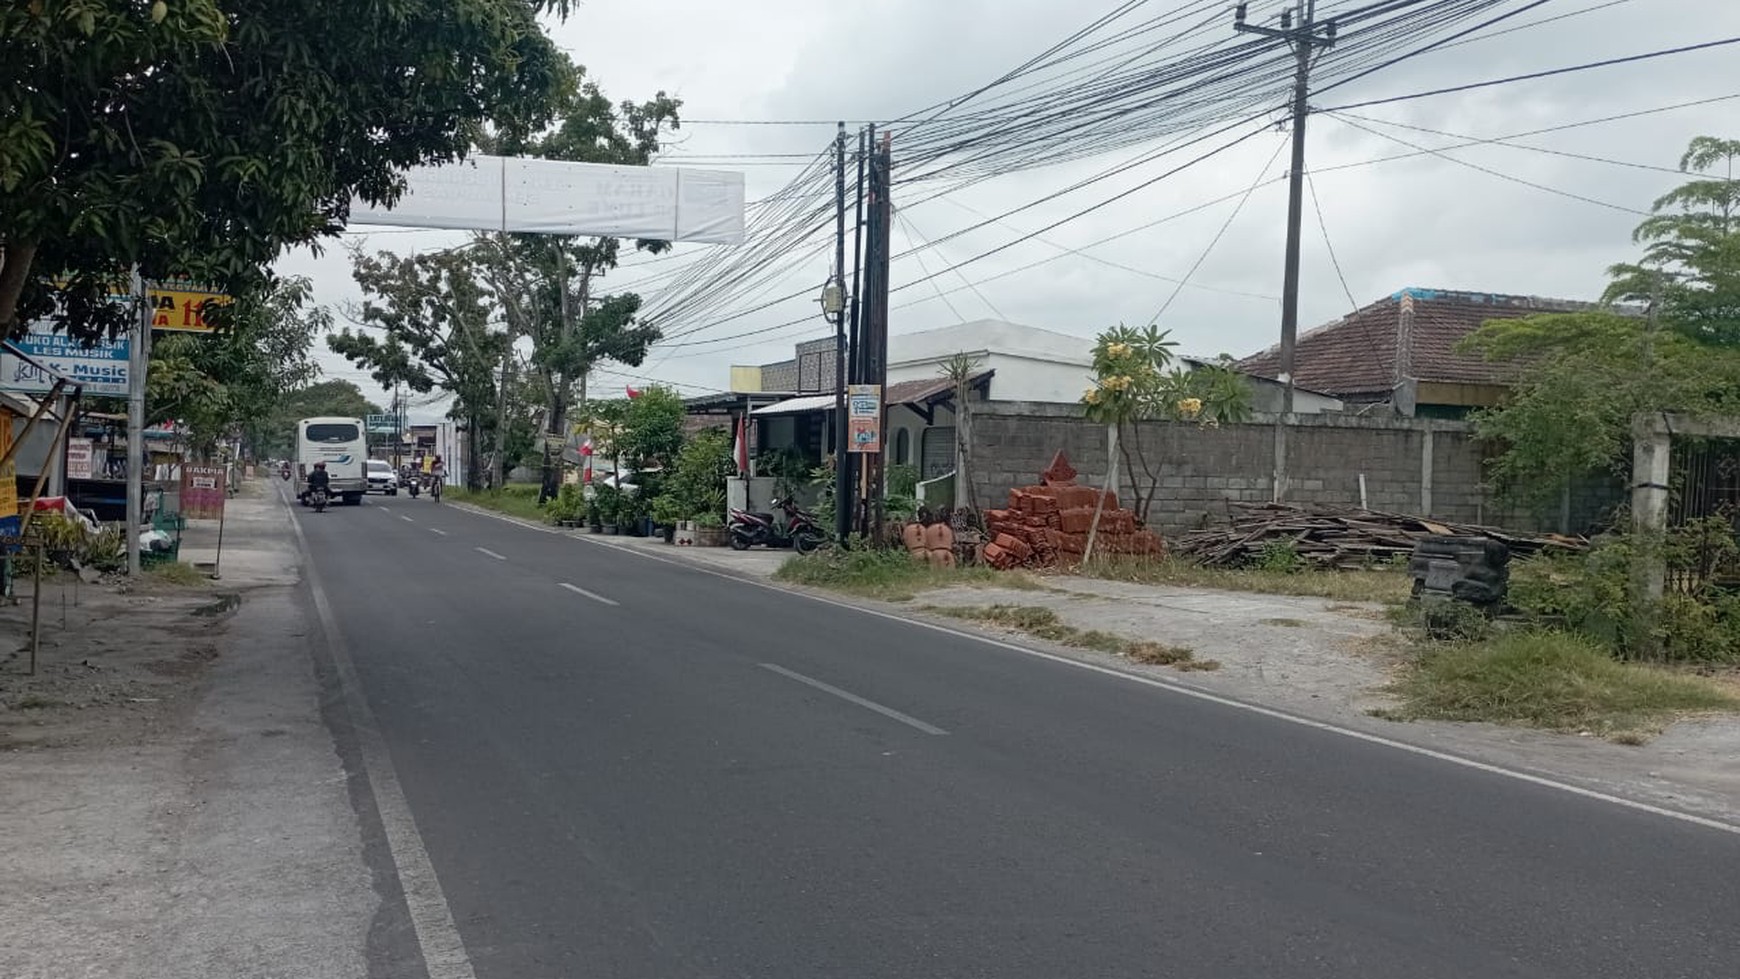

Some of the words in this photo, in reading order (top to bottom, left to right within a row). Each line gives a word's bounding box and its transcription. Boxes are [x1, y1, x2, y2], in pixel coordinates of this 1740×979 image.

[20, 335, 50, 346] OKO
[33, 346, 61, 356] LES
[65, 349, 113, 358] MUSIK
[73, 365, 127, 377] Music
